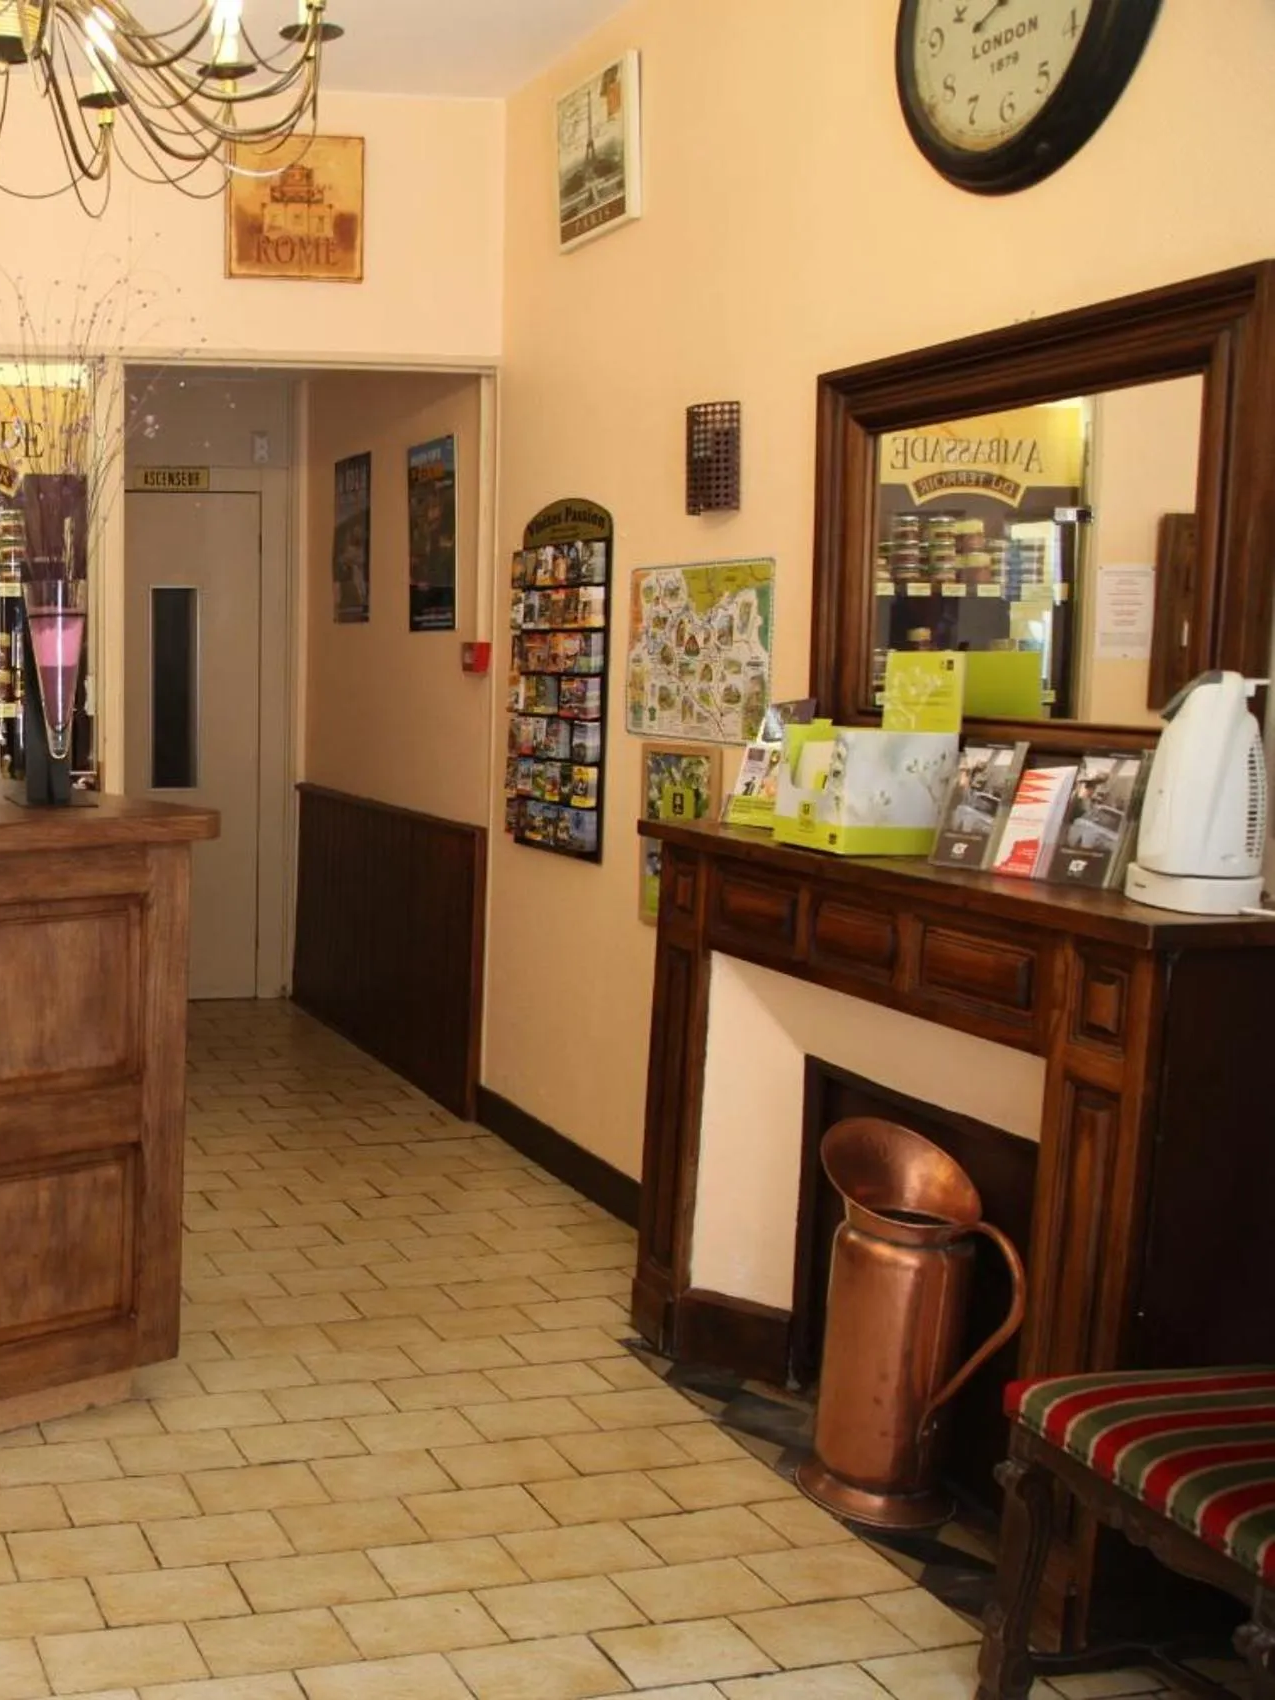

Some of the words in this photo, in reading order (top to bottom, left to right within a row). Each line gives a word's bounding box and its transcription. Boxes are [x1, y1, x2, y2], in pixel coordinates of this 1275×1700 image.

[972, 15, 1038, 60] LONDON
[1062, 9, 1079, 38] 4
[928, 27, 945, 57] 9
[942, 74, 956, 102] 8
[1035, 61, 1051, 94] 5
[967, 94, 979, 125] 7
[999, 92, 1015, 123] 6
[256, 236, 339, 266] ROME
